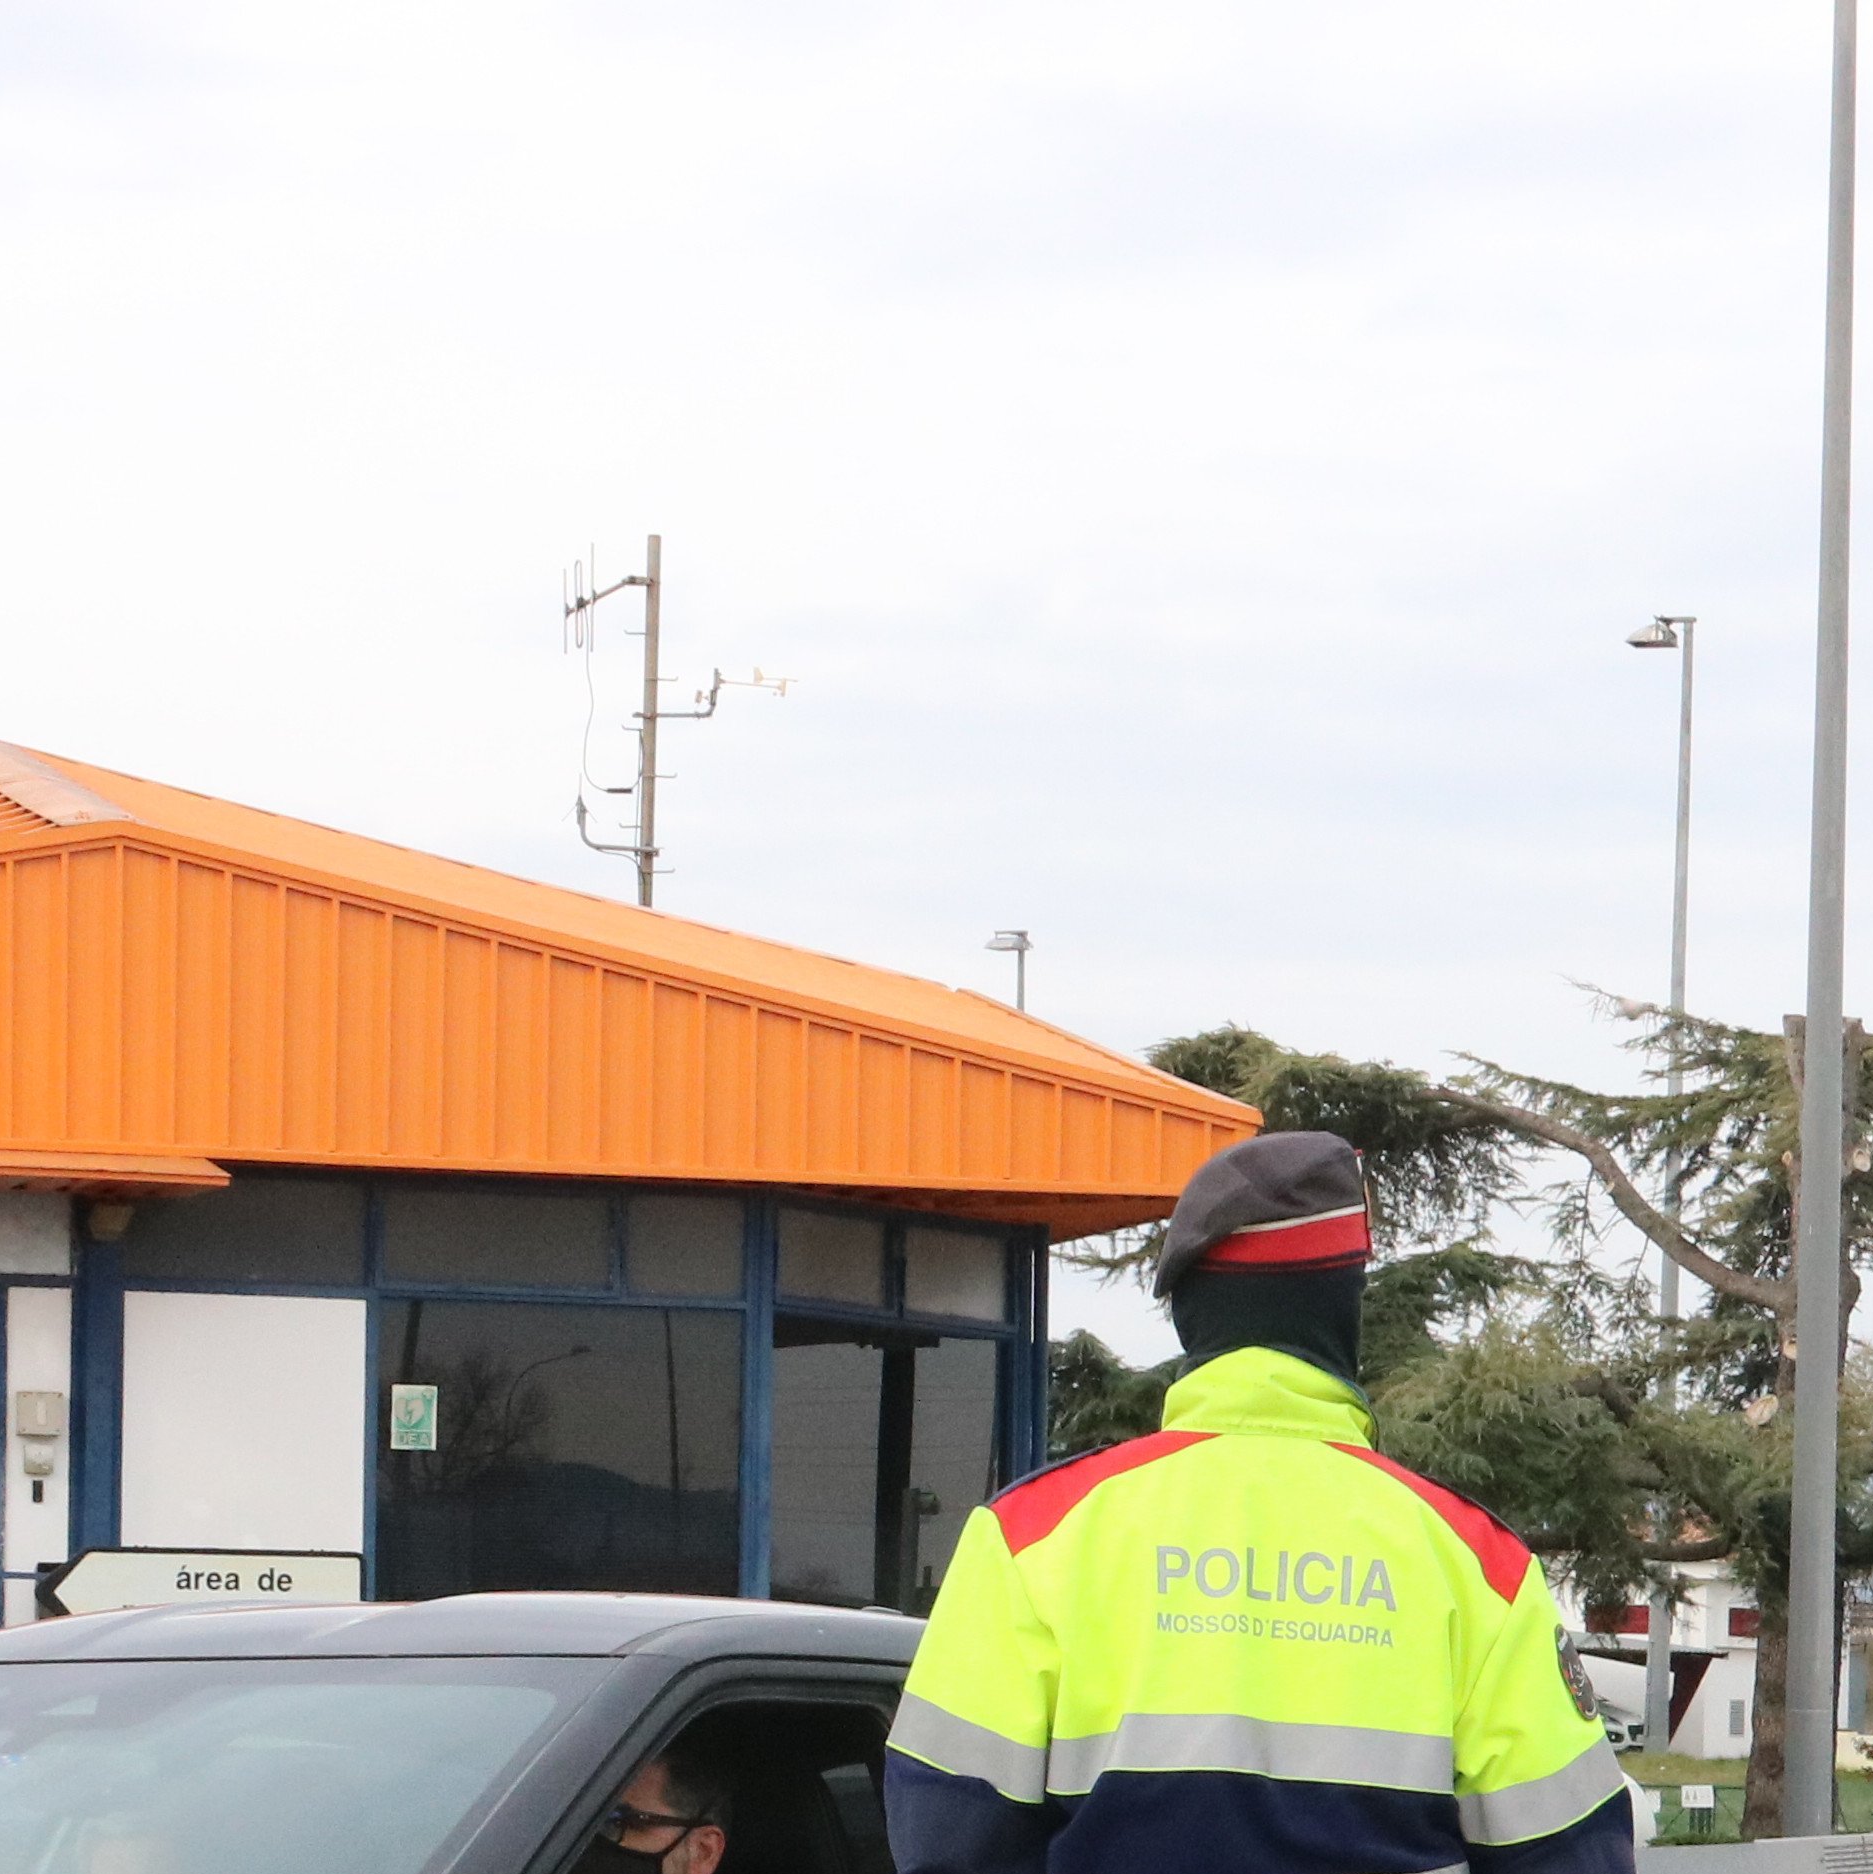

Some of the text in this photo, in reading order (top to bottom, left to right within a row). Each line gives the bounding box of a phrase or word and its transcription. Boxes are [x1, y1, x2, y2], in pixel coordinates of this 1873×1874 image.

[176, 1565, 293, 1592] área de
[1156, 1545, 1398, 1613] POLICIA
[1156, 1612, 1394, 1649] MOSSOS D'ESQUADRA
